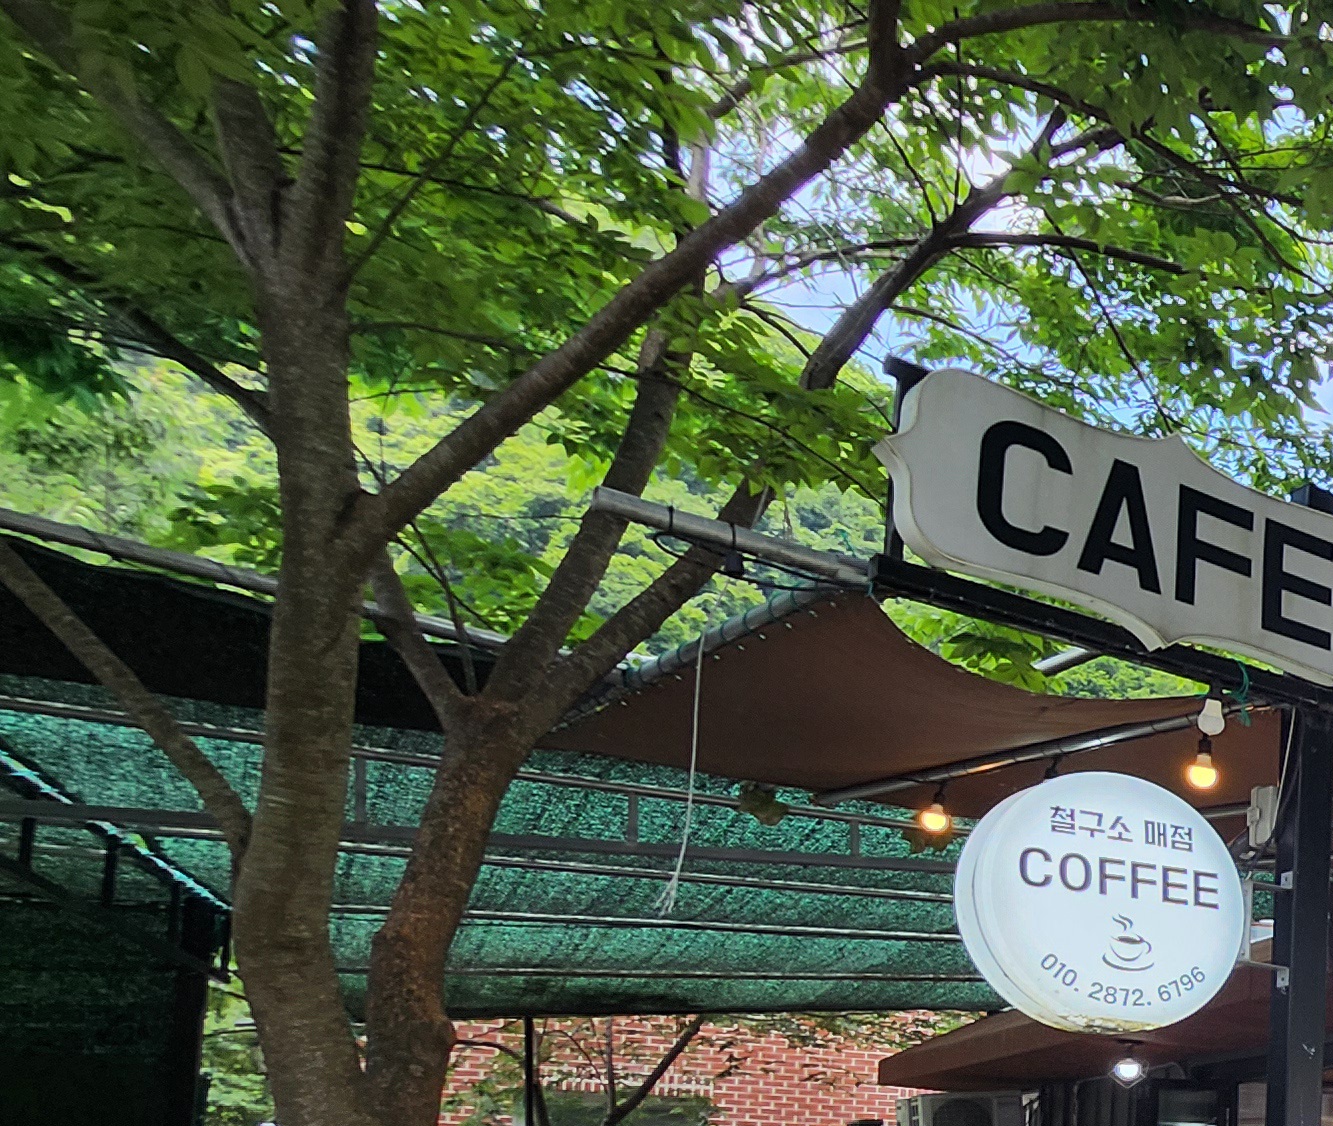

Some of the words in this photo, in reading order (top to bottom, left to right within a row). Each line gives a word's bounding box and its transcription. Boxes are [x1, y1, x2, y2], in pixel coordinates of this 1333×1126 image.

[1050, 805, 1133, 842] 철구소
[1144, 819, 1194, 853] 매점
[1018, 846, 1220, 910] COFFEE
[1040, 953, 1080, 993] 010.
[1087, 982, 1153, 1007] 2872.
[1157, 966, 1207, 1003] 6796
